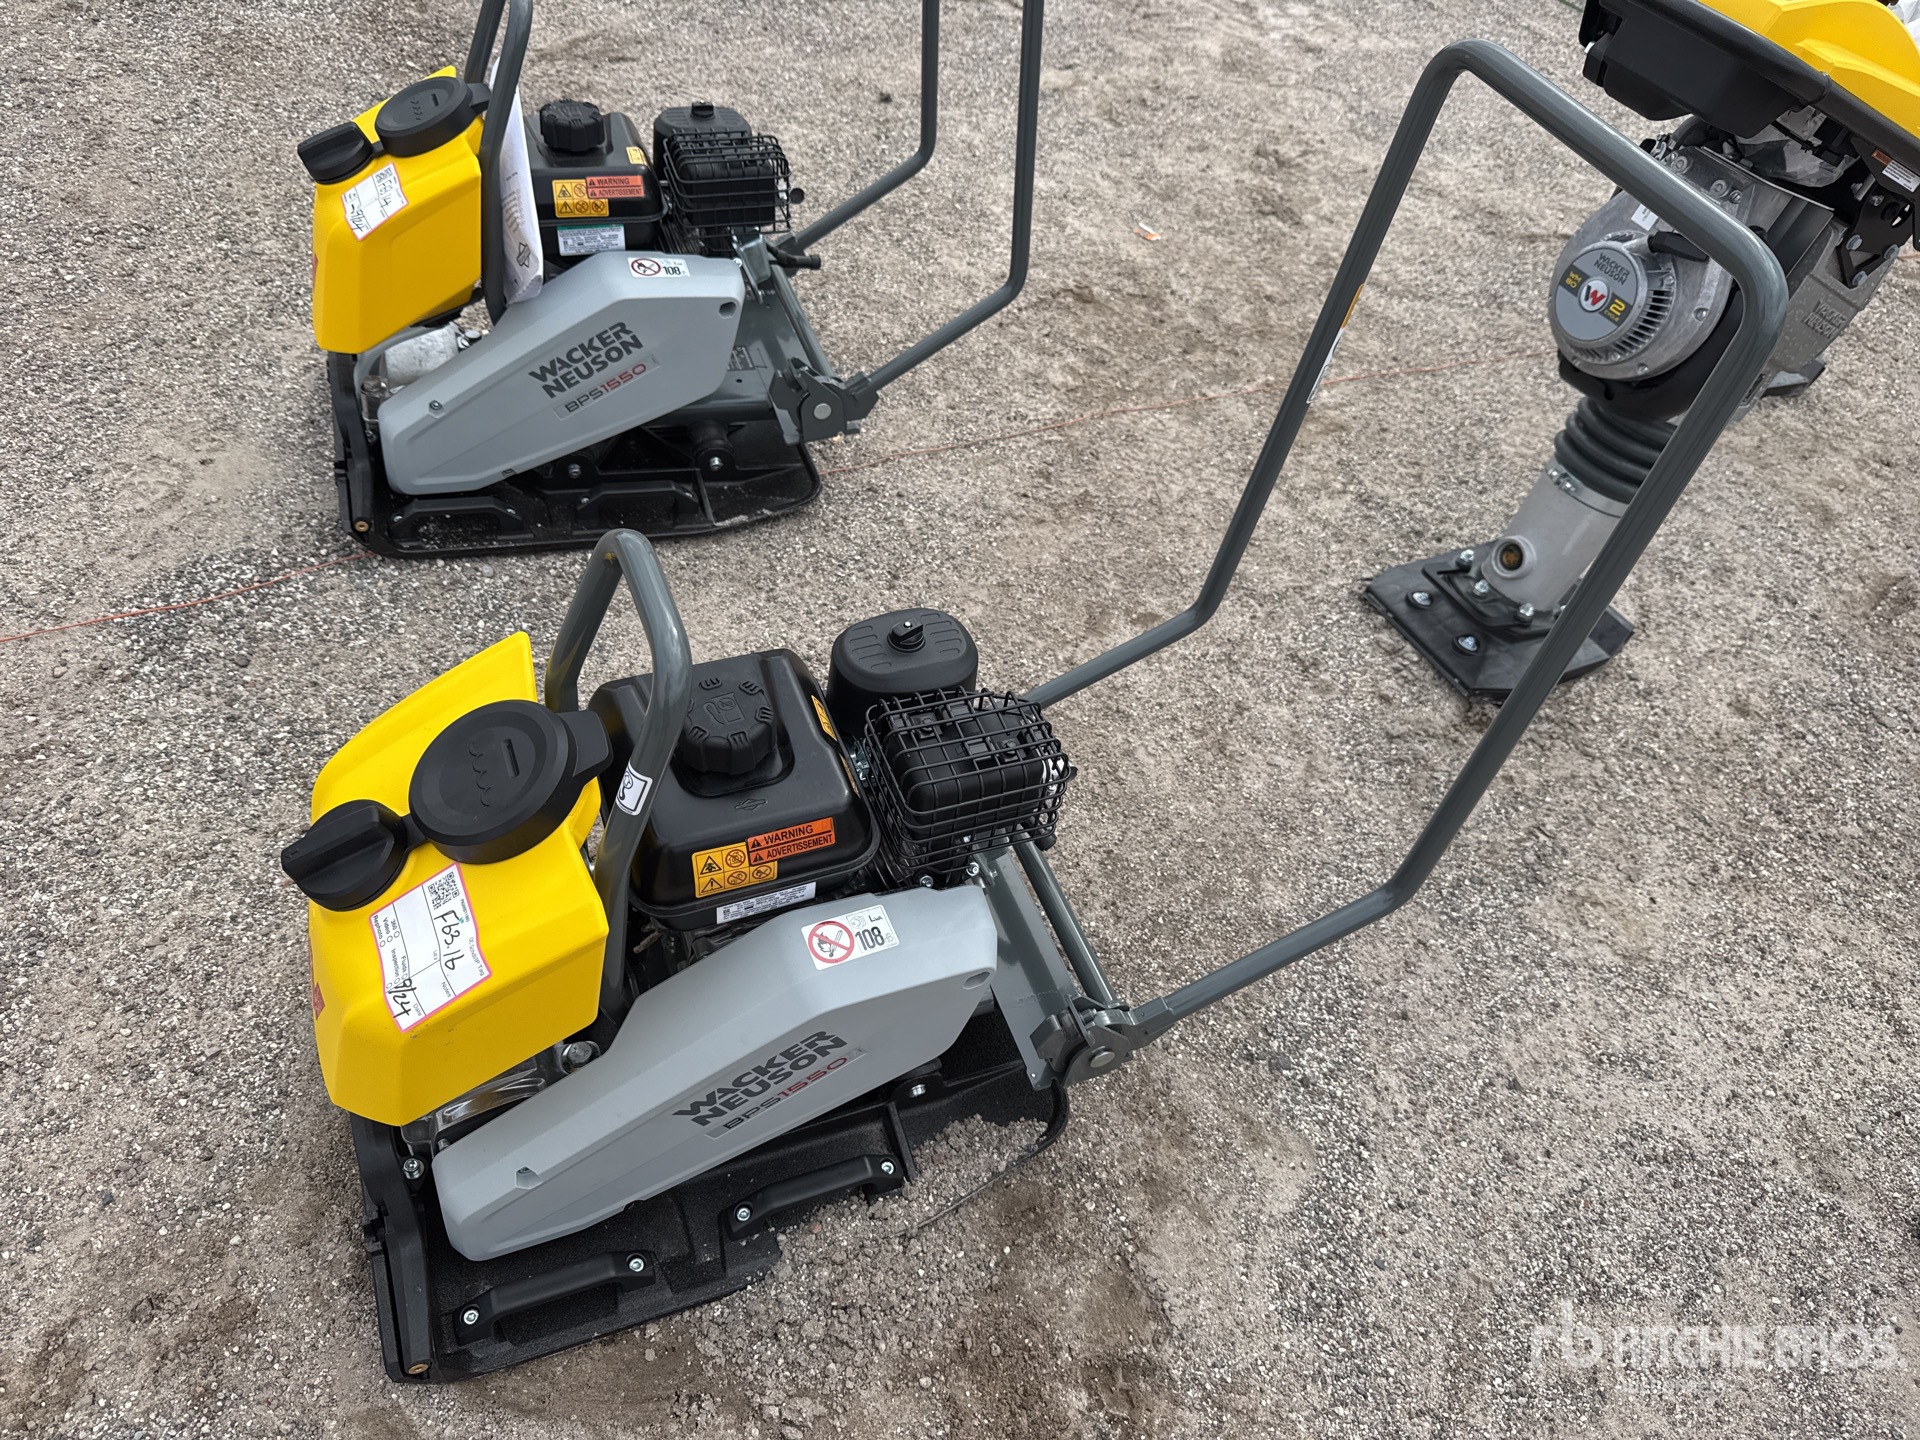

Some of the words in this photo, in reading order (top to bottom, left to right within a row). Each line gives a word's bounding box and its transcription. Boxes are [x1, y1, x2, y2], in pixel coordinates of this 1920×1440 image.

[599, 188, 642, 196] ADVERTISSEMENT
[662, 266, 681, 276] 108
[1569, 270, 1582, 282] WM
[1594, 259, 1628, 286] NEUSON
[1599, 252, 1630, 279] WACKER
[1565, 278, 1578, 288] 80
[1609, 298, 1626, 316] 2
[528, 322, 634, 382] WACKER
[542, 334, 644, 399] NEUSON
[564, 364, 647, 412] BPS1550
[764, 824, 814, 845] WARNING
[766, 834, 833, 860] ADVERTISSEMENT
[372, 914, 384, 940] Rephoto
[855, 926, 885, 951] 108
[390, 948, 400, 981] Inspection
[388, 978, 417, 1018] 9/24
[441, 982, 452, 998] Notes
[412, 1003, 422, 1016] Date
[672, 1031, 836, 1116] WACKER
[691, 1036, 848, 1126] NEUSON
[722, 1058, 848, 1130] BPS1550
